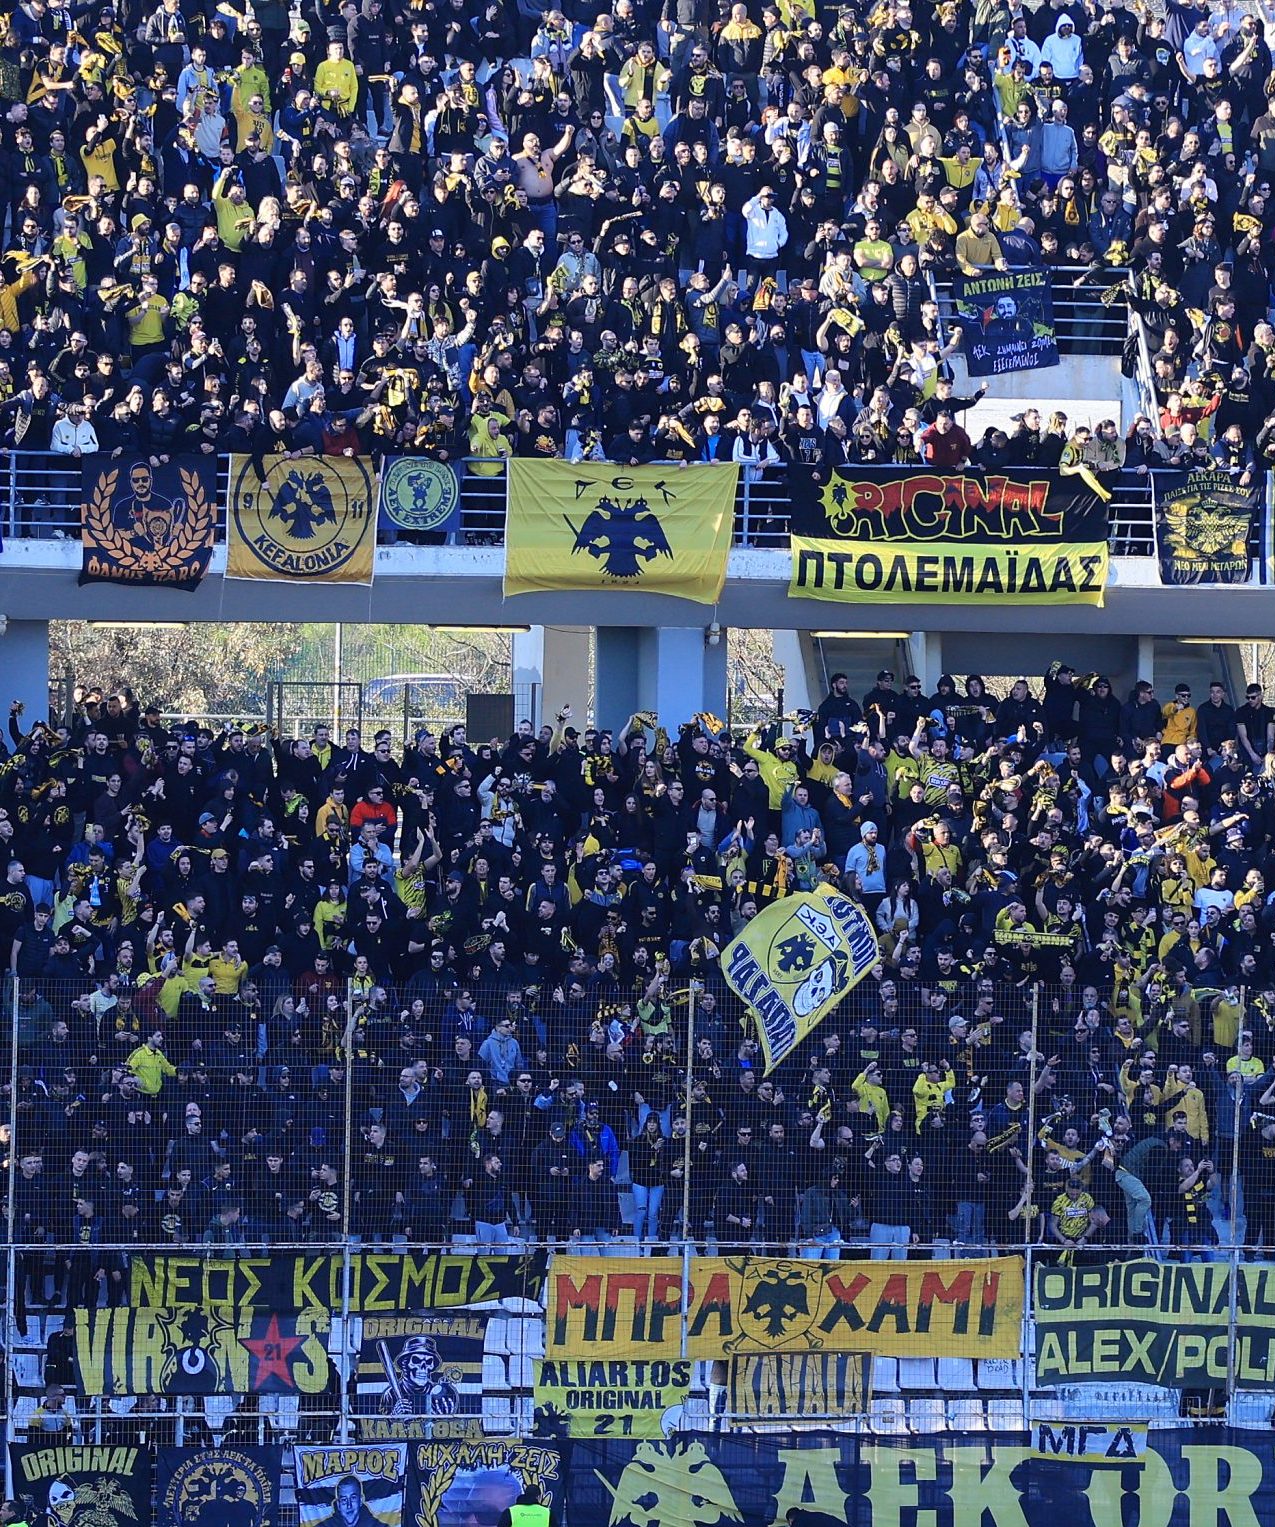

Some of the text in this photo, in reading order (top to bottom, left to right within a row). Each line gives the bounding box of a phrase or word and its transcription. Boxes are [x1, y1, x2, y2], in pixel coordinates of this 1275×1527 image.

[963, 272, 1046, 297] ΑΝΤΩΝΗ ΖΕΙΣ
[1186, 471, 1231, 484] ΑΕΚΑΡΑ
[243, 493, 364, 520] 9 11
[253, 536, 351, 573] KEFALONIA
[796, 550, 1102, 594] ΠΤΟΛΕΜΑΪΔΑΣ
[131, 1254, 509, 1311] ΝΕΟΣ ΚΟΣΜΟΣ
[363, 1317, 484, 1341] ORIGINAL
[264, 1342, 282, 1361] 21
[539, 1360, 690, 1388] ALIARTOS
[565, 1389, 666, 1410] ORIGINAL
[359, 1418, 485, 1440] ΚΑΛΛΘΕΑ
[594, 1414, 633, 1436] 21
[21, 1446, 139, 1482] ORIGINAL
[303, 1450, 398, 1484] ΜΑΡΙΟΣ
